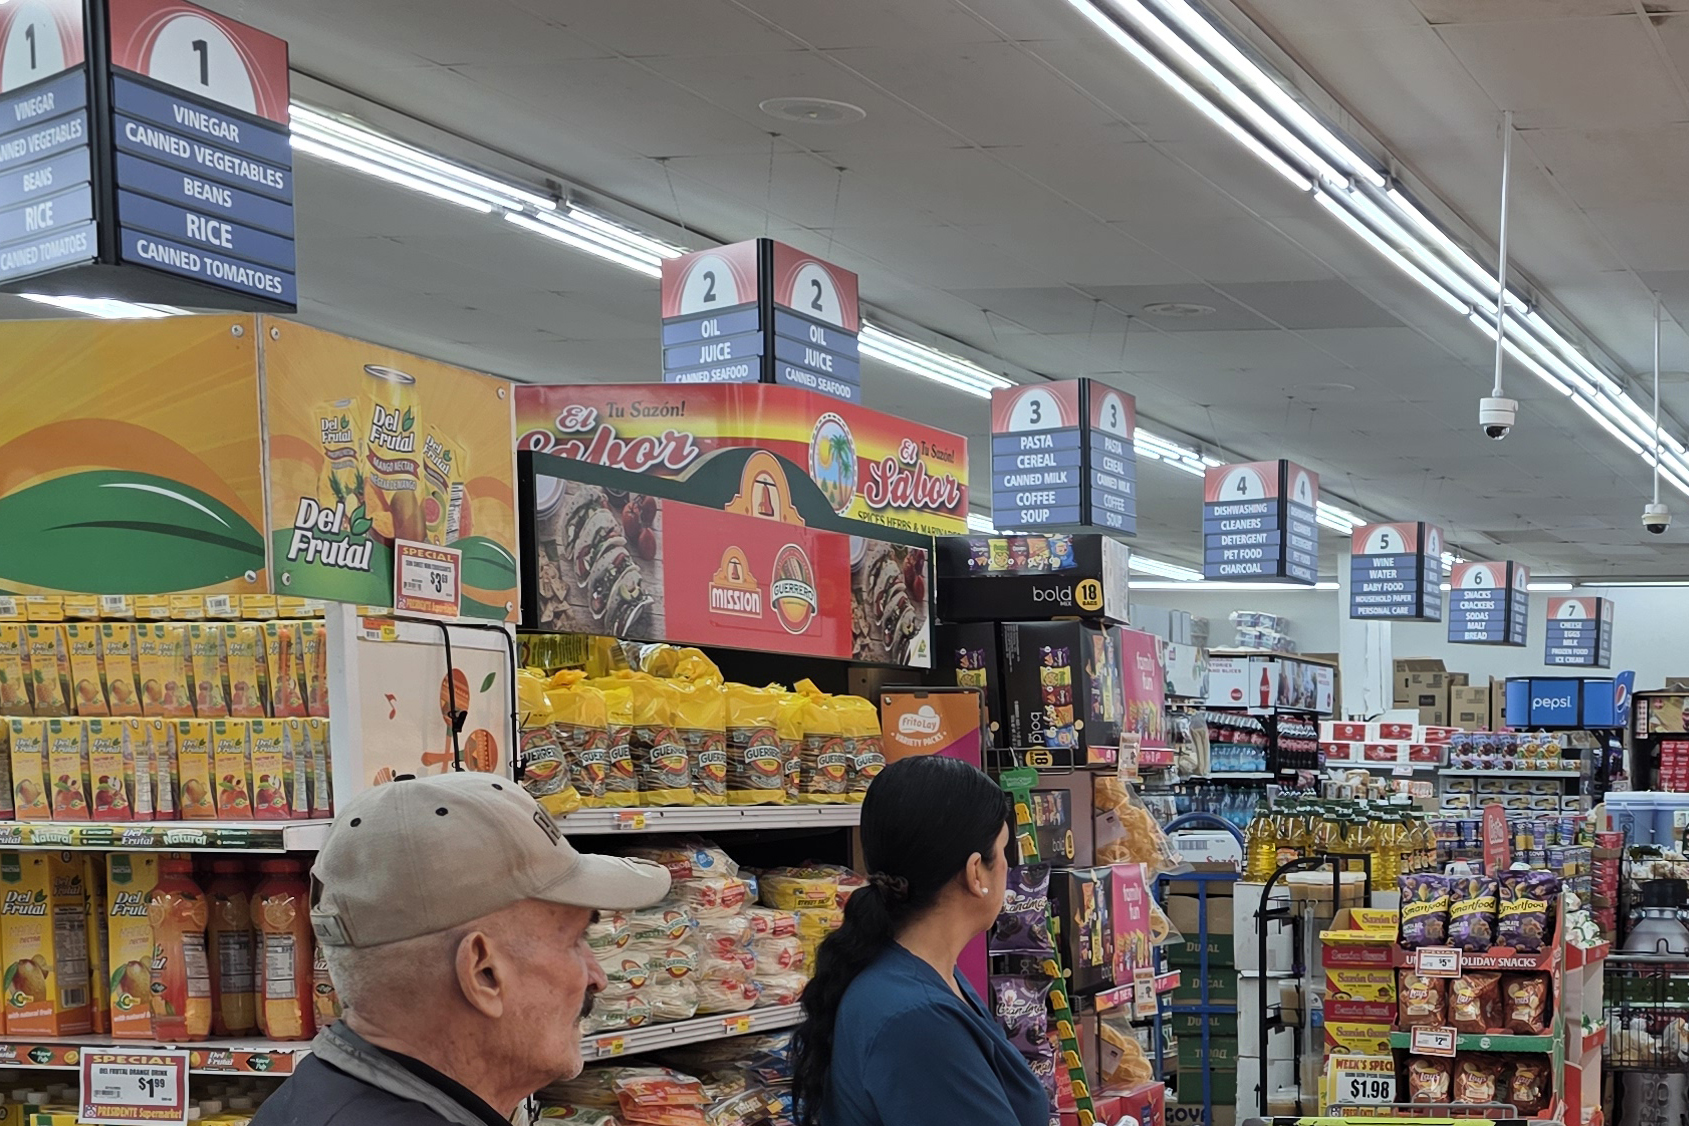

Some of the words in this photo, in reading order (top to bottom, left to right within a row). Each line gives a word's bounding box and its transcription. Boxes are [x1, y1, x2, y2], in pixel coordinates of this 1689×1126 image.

[25, 23, 36, 70] 1
[192, 39, 209, 86] 1
[15, 93, 54, 121] VINEGAR
[173, 104, 239, 143] VINEGAR
[28, 119, 82, 152] VEGETABLES
[125, 122, 190, 158] CANNED
[194, 145, 284, 189] VEGETABLES
[23, 167, 52, 192] BEANS
[184, 178, 232, 208] BEANS
[25, 202, 53, 231] RICE
[186, 213, 233, 248] RICE
[1, 244, 37, 271] CANNED
[39, 233, 87, 264] TOMATOES
[137, 239, 200, 272] CANNED
[204, 257, 282, 294] TOMATOES
[703, 271, 716, 303] 2
[811, 279, 822, 311] 2
[702, 319, 720, 338] OIL
[810, 325, 827, 346] OIL
[700, 342, 731, 363] JUICE
[804, 348, 833, 372] JUICE
[675, 371, 709, 382] CANNED
[711, 365, 748, 382] SEAFOOD
[785, 368, 816, 387] CANNED
[818, 378, 851, 398] SEAFOOD
[373, 404, 400, 432] Del
[606, 401, 626, 419] Tu
[630, 400, 686, 418] Sazón!
[1030, 400, 1041, 424] 3
[1110, 404, 1117, 428] 3
[321, 418, 338, 431] Del
[555, 404, 598, 435] El
[322, 430, 352, 444] Frutal
[370, 425, 415, 453] Frutal
[426, 435, 443, 454] Del
[1020, 435, 1053, 449] PASTA
[516, 424, 700, 474] Sabor
[898, 438, 918, 465] El
[921, 441, 930, 456] Tu
[930, 444, 955, 464] Sazón!
[1105, 438, 1122, 455] PASTA
[423, 445, 450, 475] Frutal
[1017, 453, 1057, 469] CEREAL
[865, 456, 961, 510] Sabor
[1004, 474, 1042, 487] CANNED
[1044, 472, 1067, 484] MILK
[1237, 476, 1247, 495] 4
[1016, 492, 1056, 506] COFFEE
[295, 497, 345, 534] Del
[857, 510, 886, 524] SPICES
[1021, 509, 1049, 523] SOUP
[1214, 504, 1267, 516] DISHWASHING
[1221, 518, 1261, 530] CLEANERS
[1222, 534, 1267, 545] DETERGENT
[1380, 534, 1389, 549] 5
[287, 529, 373, 571] Frutal
[403, 547, 453, 562] SPECIAL
[1224, 550, 1238, 560] PET
[1240, 549, 1262, 559] FOOD
[1220, 563, 1262, 574] CHARCOAL
[1373, 558, 1394, 567] WINE
[1369, 570, 1397, 579] WATER
[1475, 572, 1482, 585] 6
[774, 583, 814, 601] GUERRERO
[1032, 585, 1072, 602] bold
[1081, 583, 1098, 600] 18
[1383, 583, 1404, 591] FOOD
[1464, 591, 1491, 599] SNACKS
[1460, 601, 1495, 609] CRACKERS
[1569, 605, 1575, 616] 7
[1466, 612, 1488, 620] SODAS
[1532, 695, 1572, 711] pepsi
[895, 733, 922, 747] VARIETY
[923, 733, 943, 746] PACKS
[30, 831, 73, 844] Natural
[122, 835, 154, 845] Frutal
[163, 833, 207, 846] Natural
[5, 891, 32, 902] Del
[116, 892, 141, 903] Del
[1, 902, 47, 916] Frutal
[1461, 958, 1496, 966] OLIDAY
[1498, 958, 1537, 967] SNACKS
[93, 1055, 176, 1065] SPECIAL
[1336, 1059, 1367, 1070] WEEK'S
[1351, 1079, 1389, 1099] $1.98
[98, 1106, 138, 1117] PRESIDENTE
[139, 1109, 182, 1119] Supermarket
